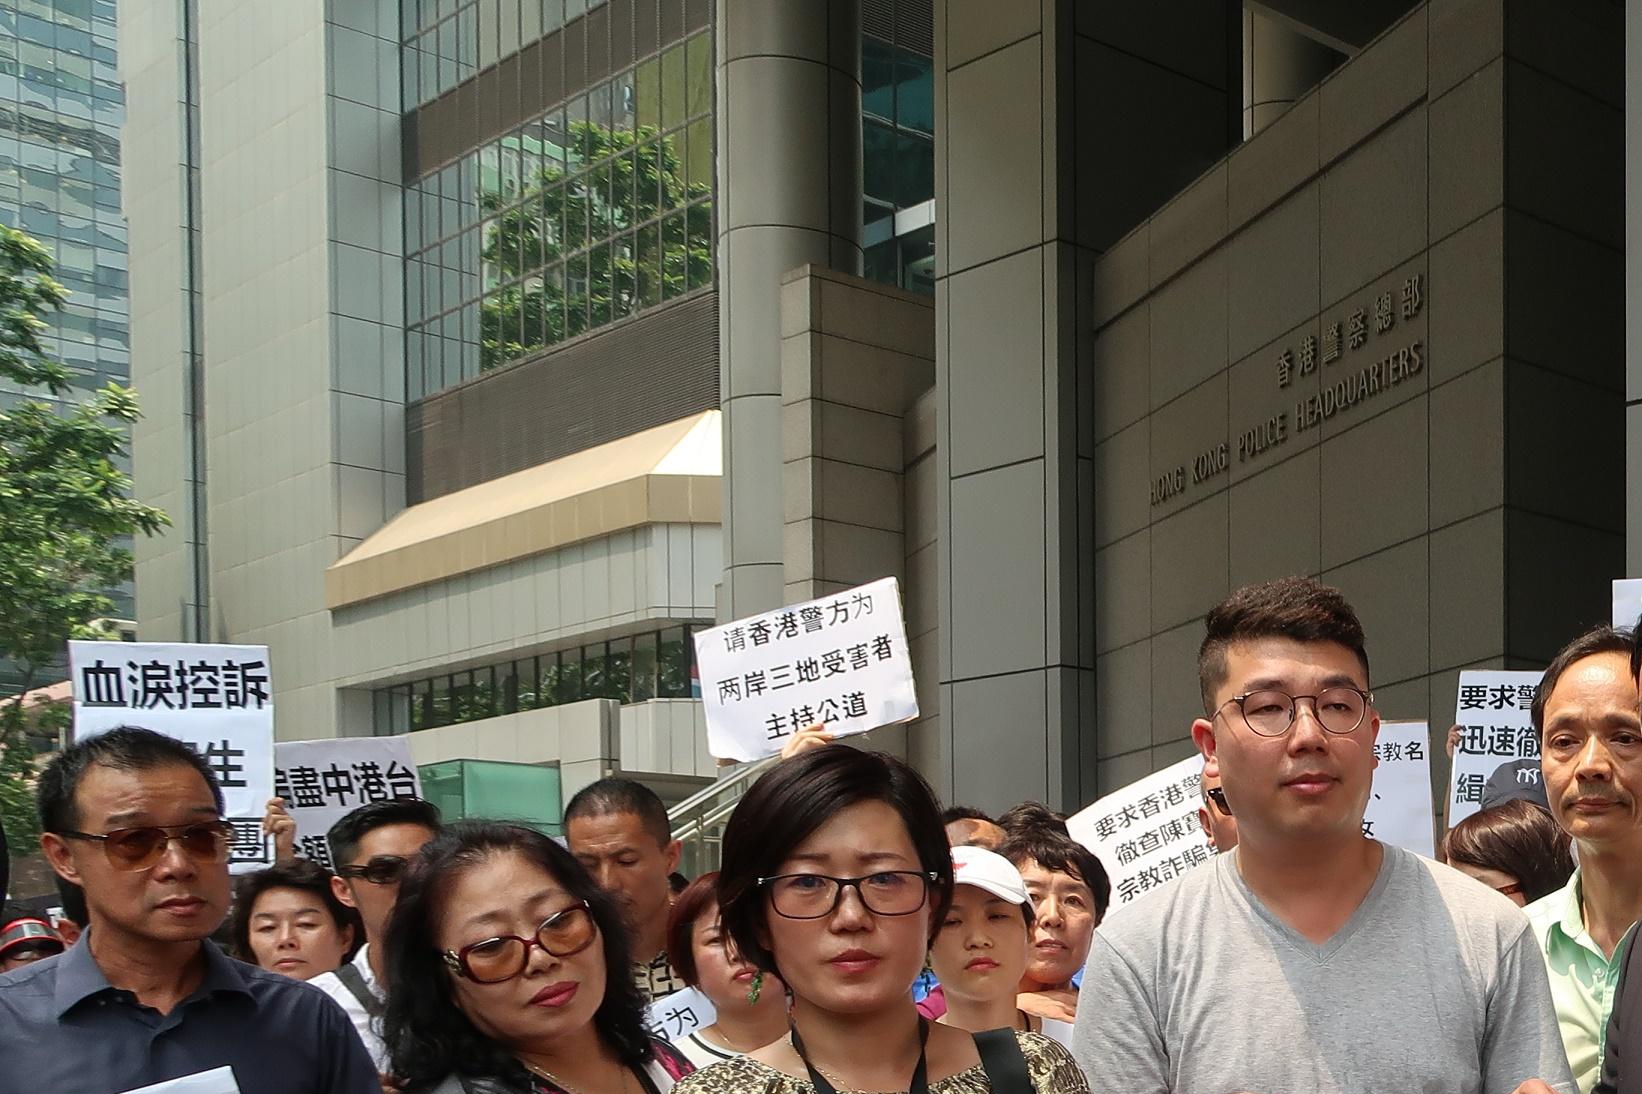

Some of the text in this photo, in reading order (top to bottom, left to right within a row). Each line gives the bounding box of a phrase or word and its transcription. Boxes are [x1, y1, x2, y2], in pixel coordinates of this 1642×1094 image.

[1277, 273, 1424, 389] 香港警察總部
[1150, 340, 1424, 505] HONG KONG POLICE HEADQUARTERS
[723, 592, 874, 653] 请香港警方为
[82, 660, 269, 710] 血淚控訴
[717, 633, 893, 705] 两岸三地受害者
[765, 691, 869, 740] 主持公道
[185, 740, 247, 789] 生
